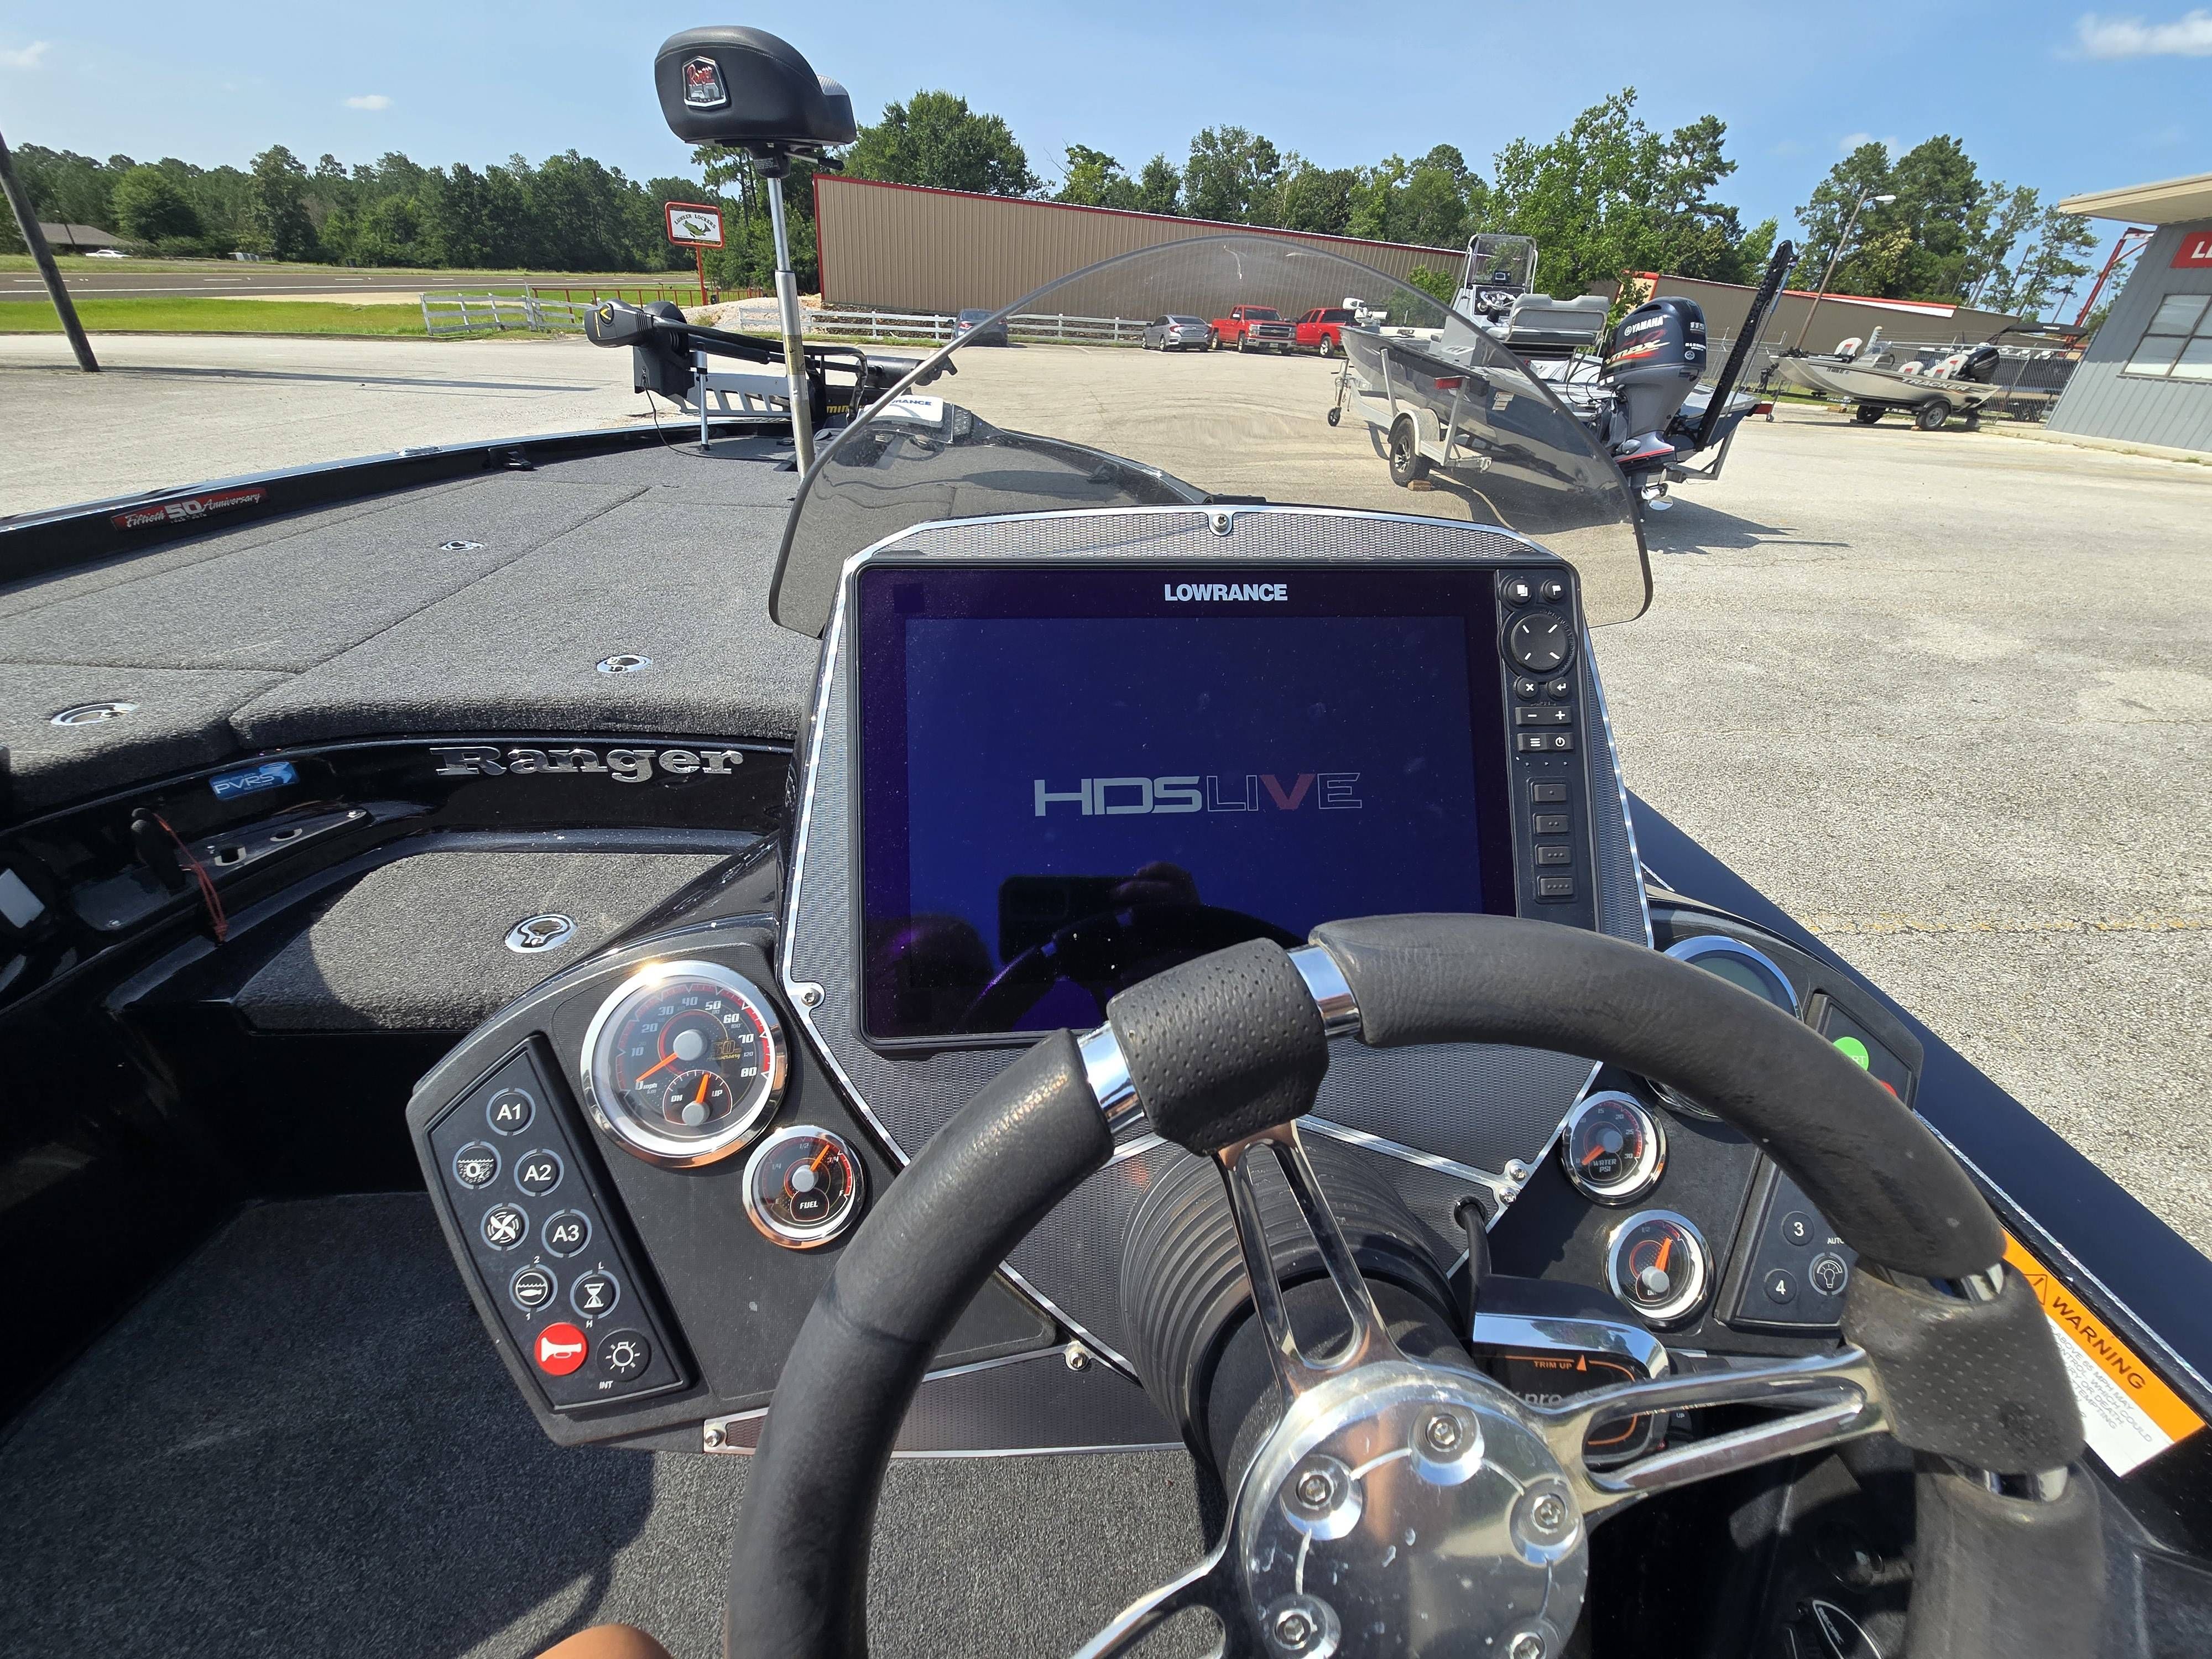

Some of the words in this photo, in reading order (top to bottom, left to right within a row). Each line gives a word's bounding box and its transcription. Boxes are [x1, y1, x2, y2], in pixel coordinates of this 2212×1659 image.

[674, 214, 692, 225] LUNKER
[695, 214, 717, 229] LOCKERS
[1632, 316, 1663, 333] YAMAHA
[1902, 377, 1969, 391] TRACKER
[125, 510, 165, 528] Fiftieth
[164, 500, 203, 519] 50
[202, 493, 260, 512] Anniversary
[1165, 583, 1287, 602] LOWRANCE
[429, 746, 743, 783] Ranger
[213, 774, 275, 794] PVRS
[682, 997, 698, 1006] 40
[705, 1000, 721, 1010] 50
[658, 1006, 675, 1016] 30
[723, 1013, 740, 1023] 60
[641, 1023, 658, 1033] 20
[738, 1034, 754, 1044] 70
[631, 1047, 644, 1057] 10
[740, 1067, 757, 1078] 80
[671, 1094, 683, 1103] DN
[496, 1103, 522, 1120] A1
[523, 1162, 552, 1182] A2
[800, 1200, 818, 1210] FUEL
[551, 1224, 580, 1243] A3
[1793, 1222, 1804, 1237] 3
[534, 1256, 540, 1264] 2
[597, 1261, 604, 1270] L
[1775, 1280, 1786, 1295] 4
[2052, 1296, 2146, 1390] WARNING
[1533, 1360, 1557, 1369] TRIM
[2054, 1332, 2084, 1361] ABOVE
[2083, 1360, 2094, 1371] 65
[2093, 1371, 2114, 1392] MPH
[2114, 1391, 2137, 1410] MAY
[598, 1380, 613, 1390] INT
[2081, 1380, 2094, 1394] OR
[2072, 1379, 2118, 1430] TTEMPTING
[2090, 1379, 2120, 1410] WHICH
[2120, 1408, 2153, 1442] COULD
